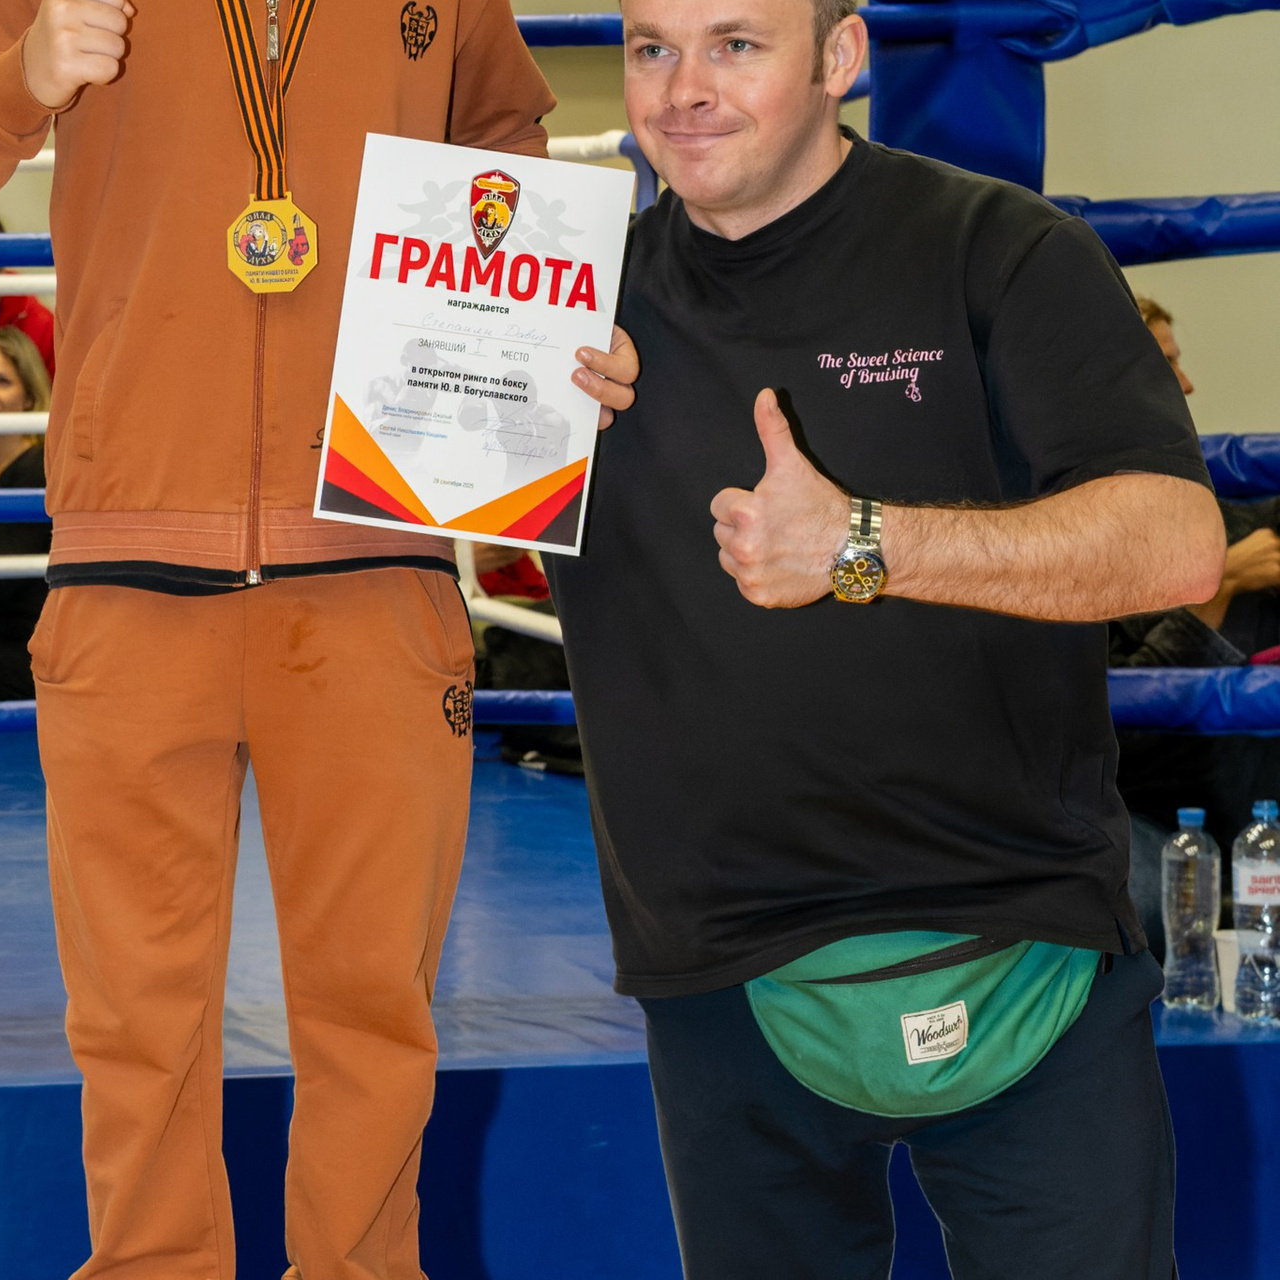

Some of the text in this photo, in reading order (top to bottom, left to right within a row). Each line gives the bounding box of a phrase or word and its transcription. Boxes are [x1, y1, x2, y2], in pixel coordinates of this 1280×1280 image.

[369, 232, 598, 312] ГРАМОТА
[447, 298, 510, 315] награждается
[418, 337, 466, 354] ЗАНЯВШИЙ
[500, 350, 530, 363] МЕСТО
[817, 348, 944, 369] The Sweet Science
[411, 365, 529, 391] в открытом ринге по боксу
[840, 366, 920, 389] of Bruising
[407, 378, 528, 403] памяти Ю. В. Богуславского
